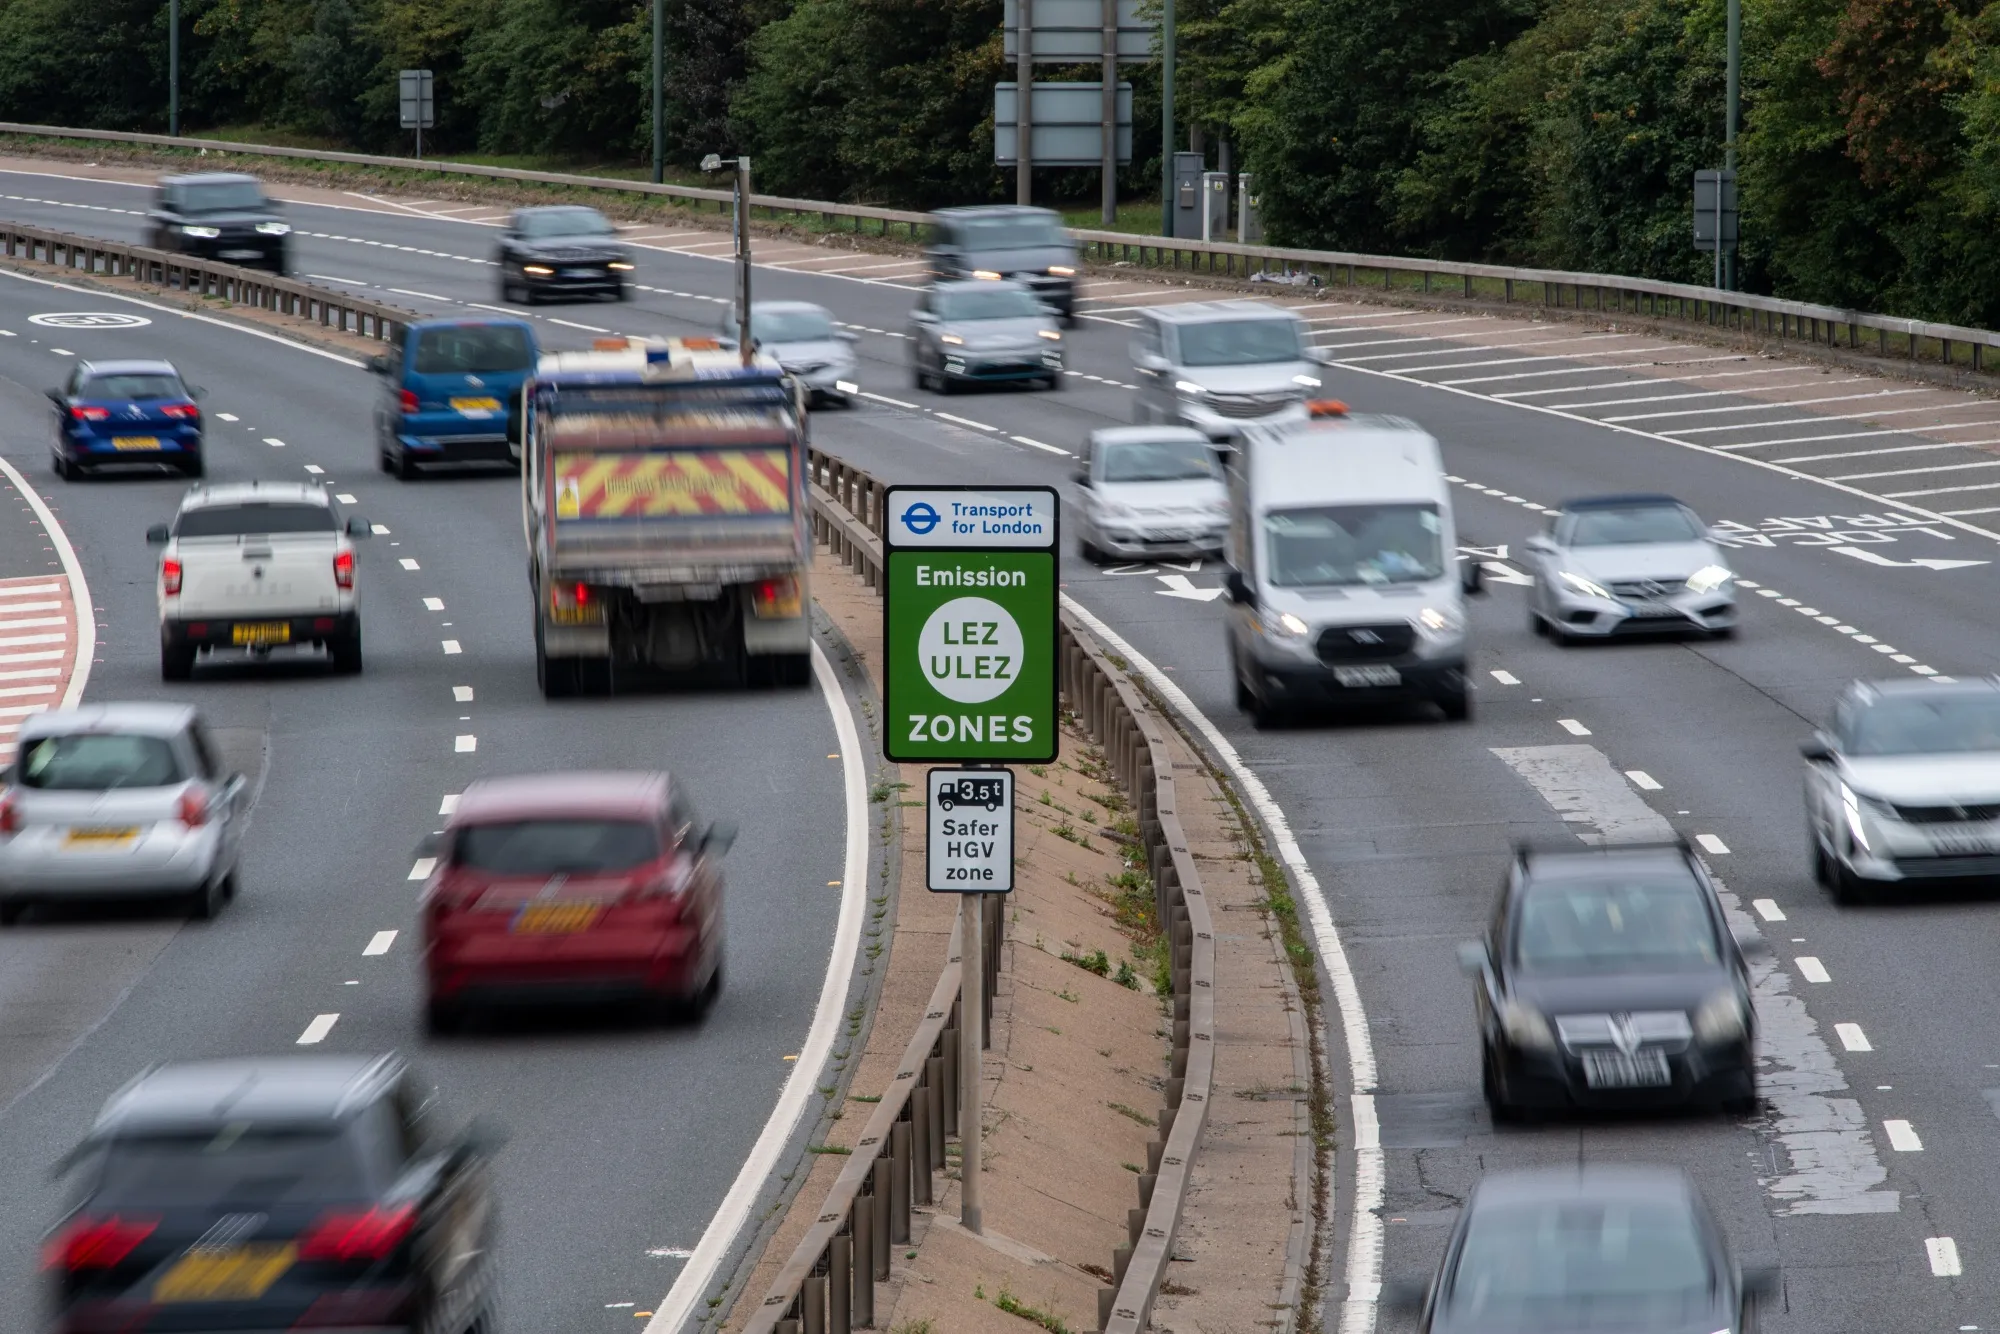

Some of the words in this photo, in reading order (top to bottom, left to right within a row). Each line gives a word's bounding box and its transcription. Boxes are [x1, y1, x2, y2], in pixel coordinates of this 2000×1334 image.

[44, 316, 134, 325] 50
[951, 502, 1033, 519] Transport
[951, 519, 976, 534] for
[982, 519, 1042, 534] London
[1711, 512, 1942, 532] TRAFF
[916, 565, 1026, 587] Emission
[943, 621, 999, 646] LEZ
[931, 655, 1011, 680] ULEZ
[908, 714, 1033, 743] ZONES
[942, 819, 999, 836] Safer
[947, 841, 995, 858] HGV
[946, 867, 994, 880] zone
